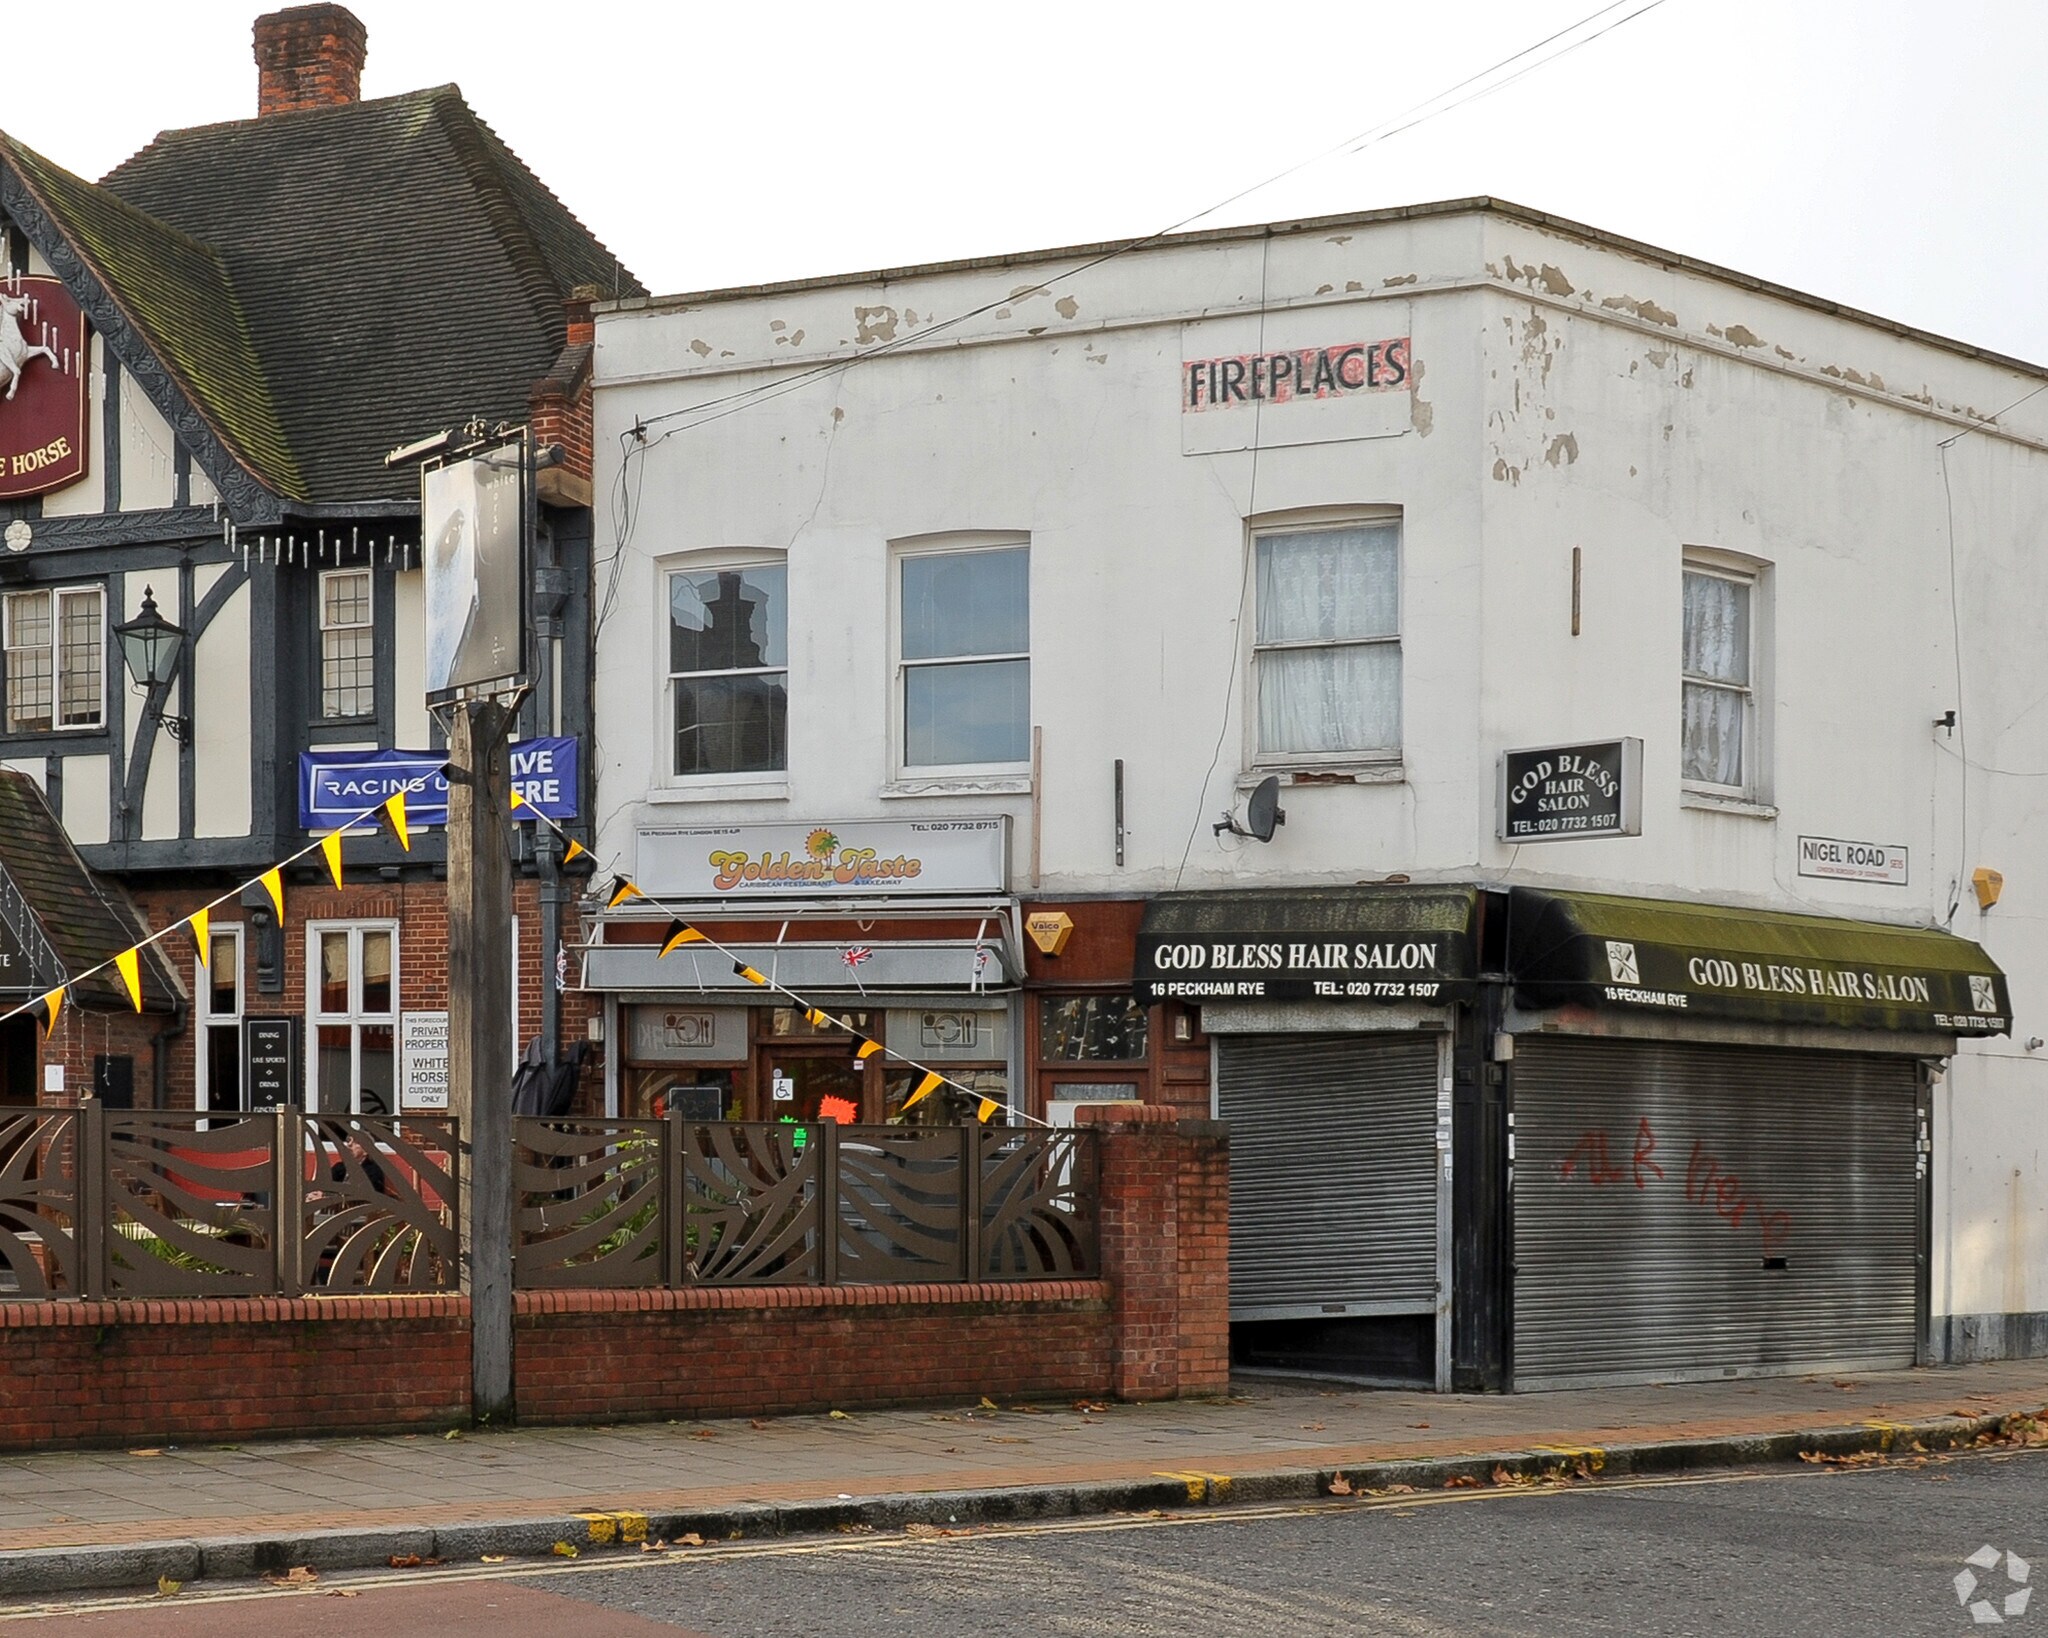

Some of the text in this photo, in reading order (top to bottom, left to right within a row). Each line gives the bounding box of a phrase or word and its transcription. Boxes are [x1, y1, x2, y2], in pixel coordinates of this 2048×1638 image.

[1190, 340, 1406, 406] FIREPLACES
[11, 436, 72, 475] HORSE
[510, 750, 553, 777] IVE
[324, 776, 449, 797] RACING U
[1510, 754, 1619, 804] GOD BLESS
[1544, 777, 1585, 795] HAIR
[1537, 794, 1590, 813] SALON
[930, 823, 949, 831] 020
[951, 822, 975, 831] 7732
[1561, 816, 1588, 830] 7732
[1590, 813, 1617, 828] 1507
[1803, 841, 1885, 867] NIGEL ROAD
[708, 847, 922, 890] Golden Taste
[1154, 943, 1438, 969] GOD BLESS HAIR SALON
[1150, 982, 1265, 996] 16 PECKHAM RYE
[1313, 981, 1440, 997] TEL: 020 7732 1507
[1688, 957, 1930, 1003] GOD BLESS HAIR SALON
[1604, 986, 1688, 1008] 16 PECKHAM RYE
[411, 1026, 449, 1036] PRIVATE
[405, 1039, 449, 1049] PROPERT
[412, 1057, 449, 1068] WHITE
[411, 1072, 449, 1083] HORSE
[421, 1095, 441, 1103] ONLY
